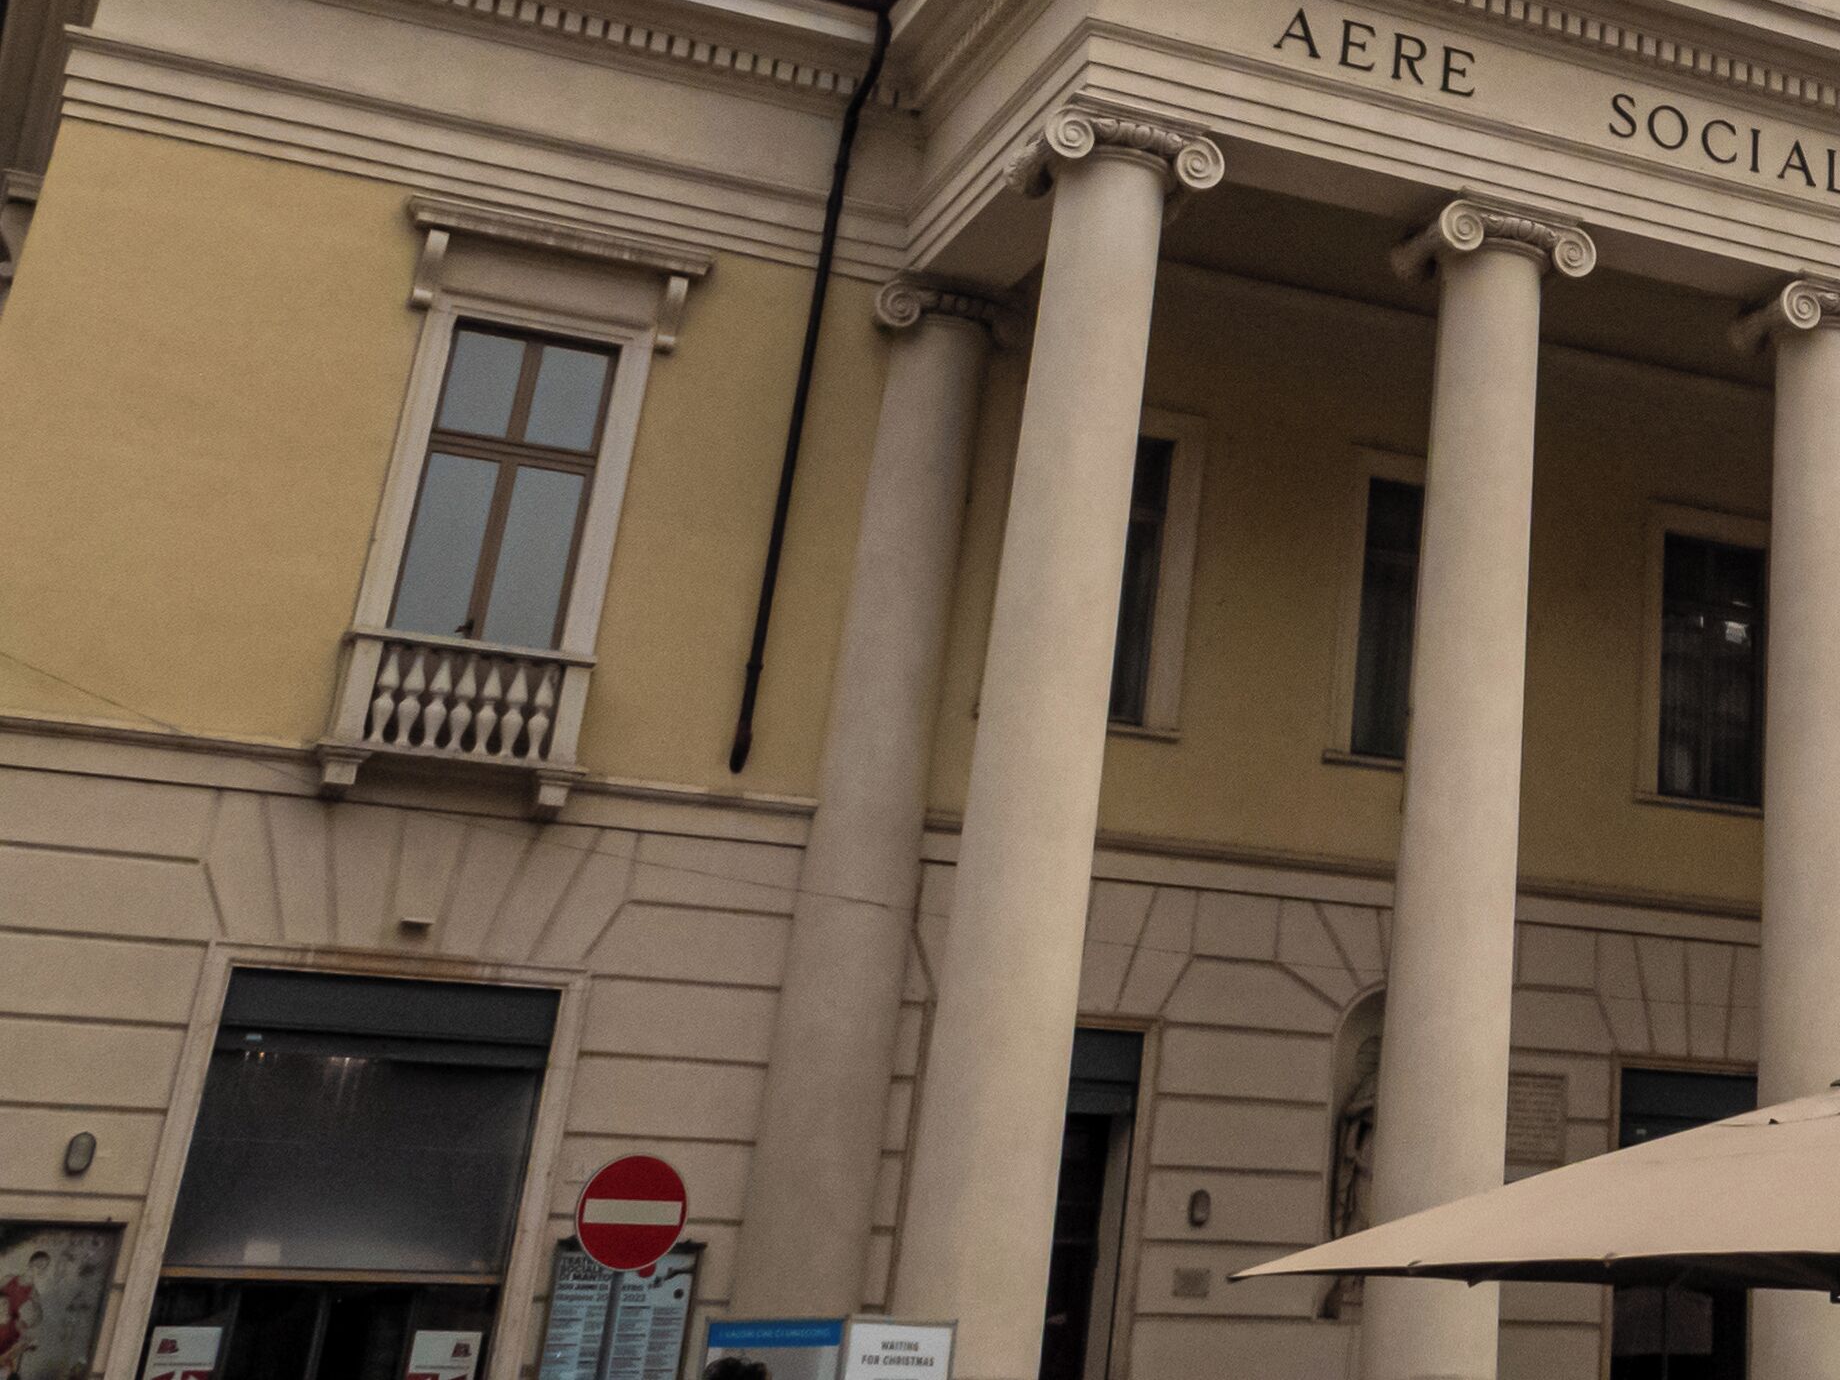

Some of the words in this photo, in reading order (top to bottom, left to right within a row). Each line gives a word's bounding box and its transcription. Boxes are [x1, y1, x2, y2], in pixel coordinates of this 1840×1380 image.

[1273, 7, 1476, 98] AERE
[881, 1340, 919, 1352] WAITING
[861, 1354, 880, 1365] FOR
[883, 1355, 935, 1367] CHRISTMAS
